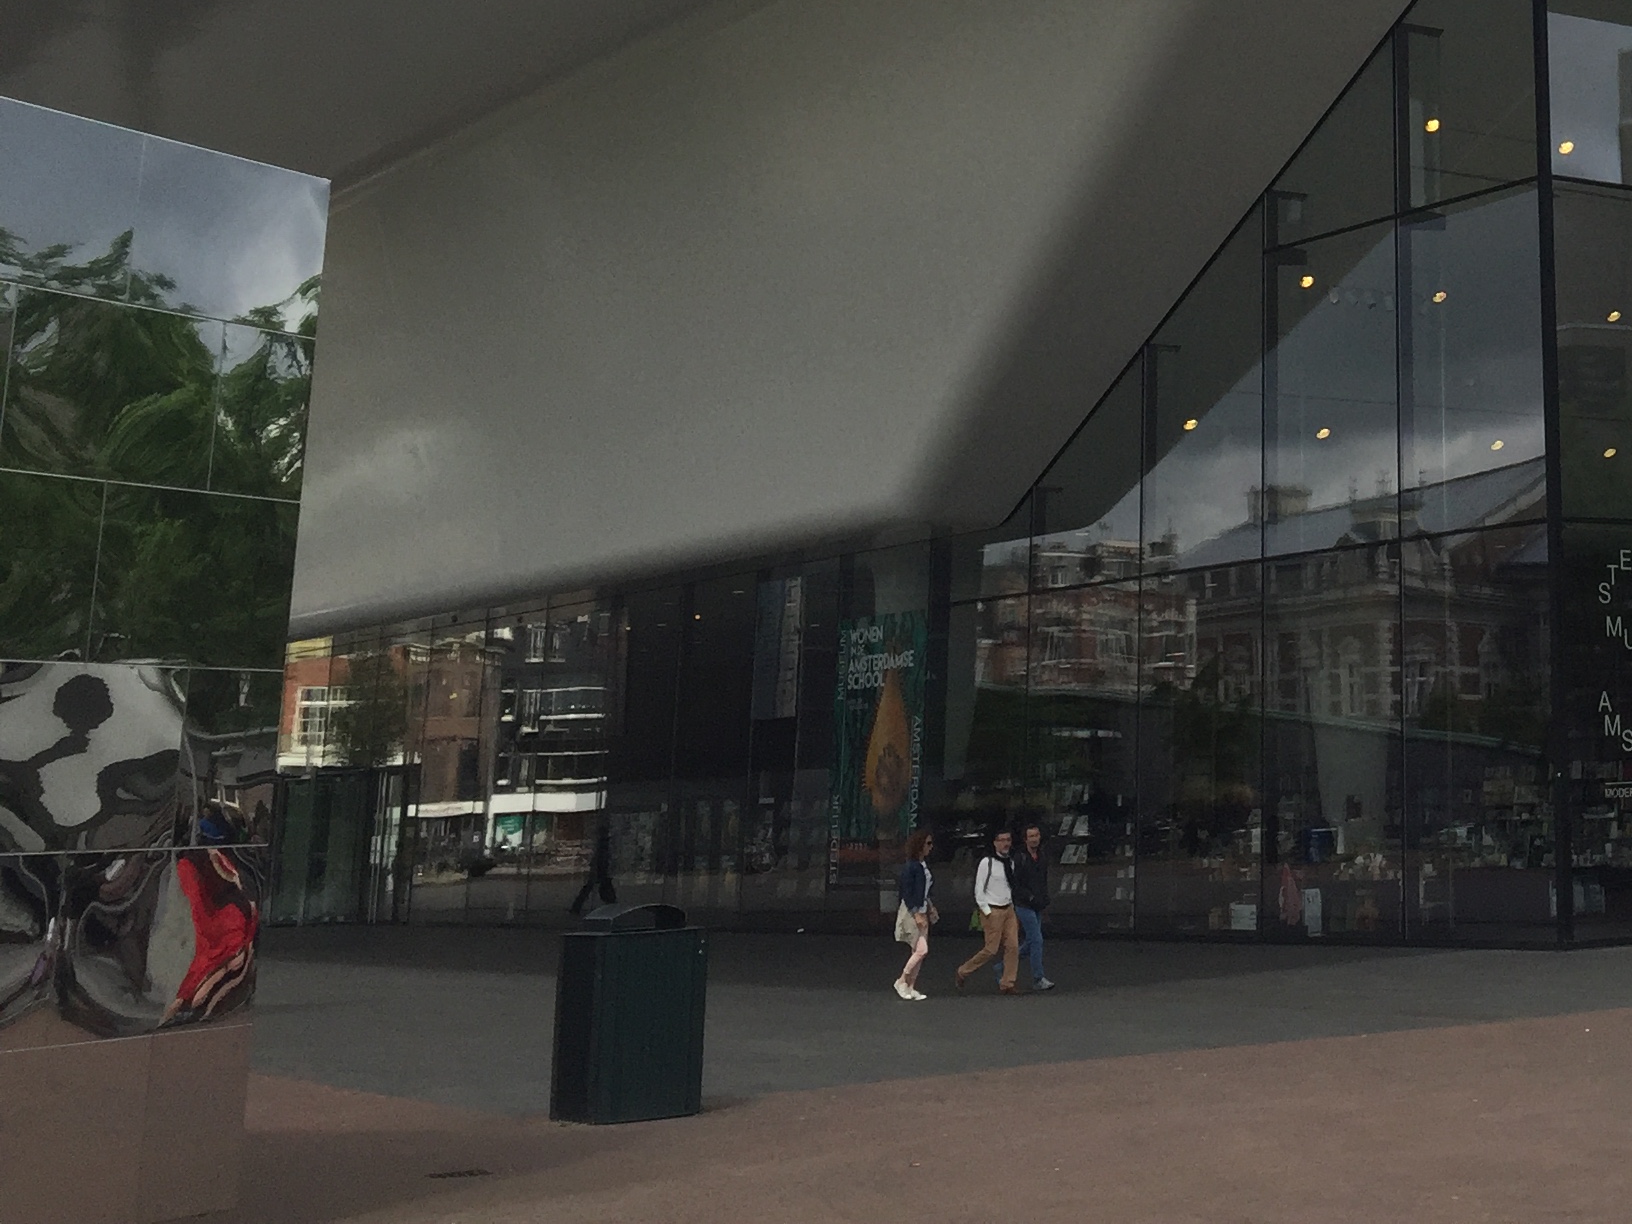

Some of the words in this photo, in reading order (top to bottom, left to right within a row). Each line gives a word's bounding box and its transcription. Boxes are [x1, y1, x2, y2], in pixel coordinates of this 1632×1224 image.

[849, 625, 884, 644] WONEN
[847, 650, 915, 672] AMSTERDAMSE
[847, 671, 885, 690] SCHOOL
[910, 716, 922, 828] AMSTERDAM
